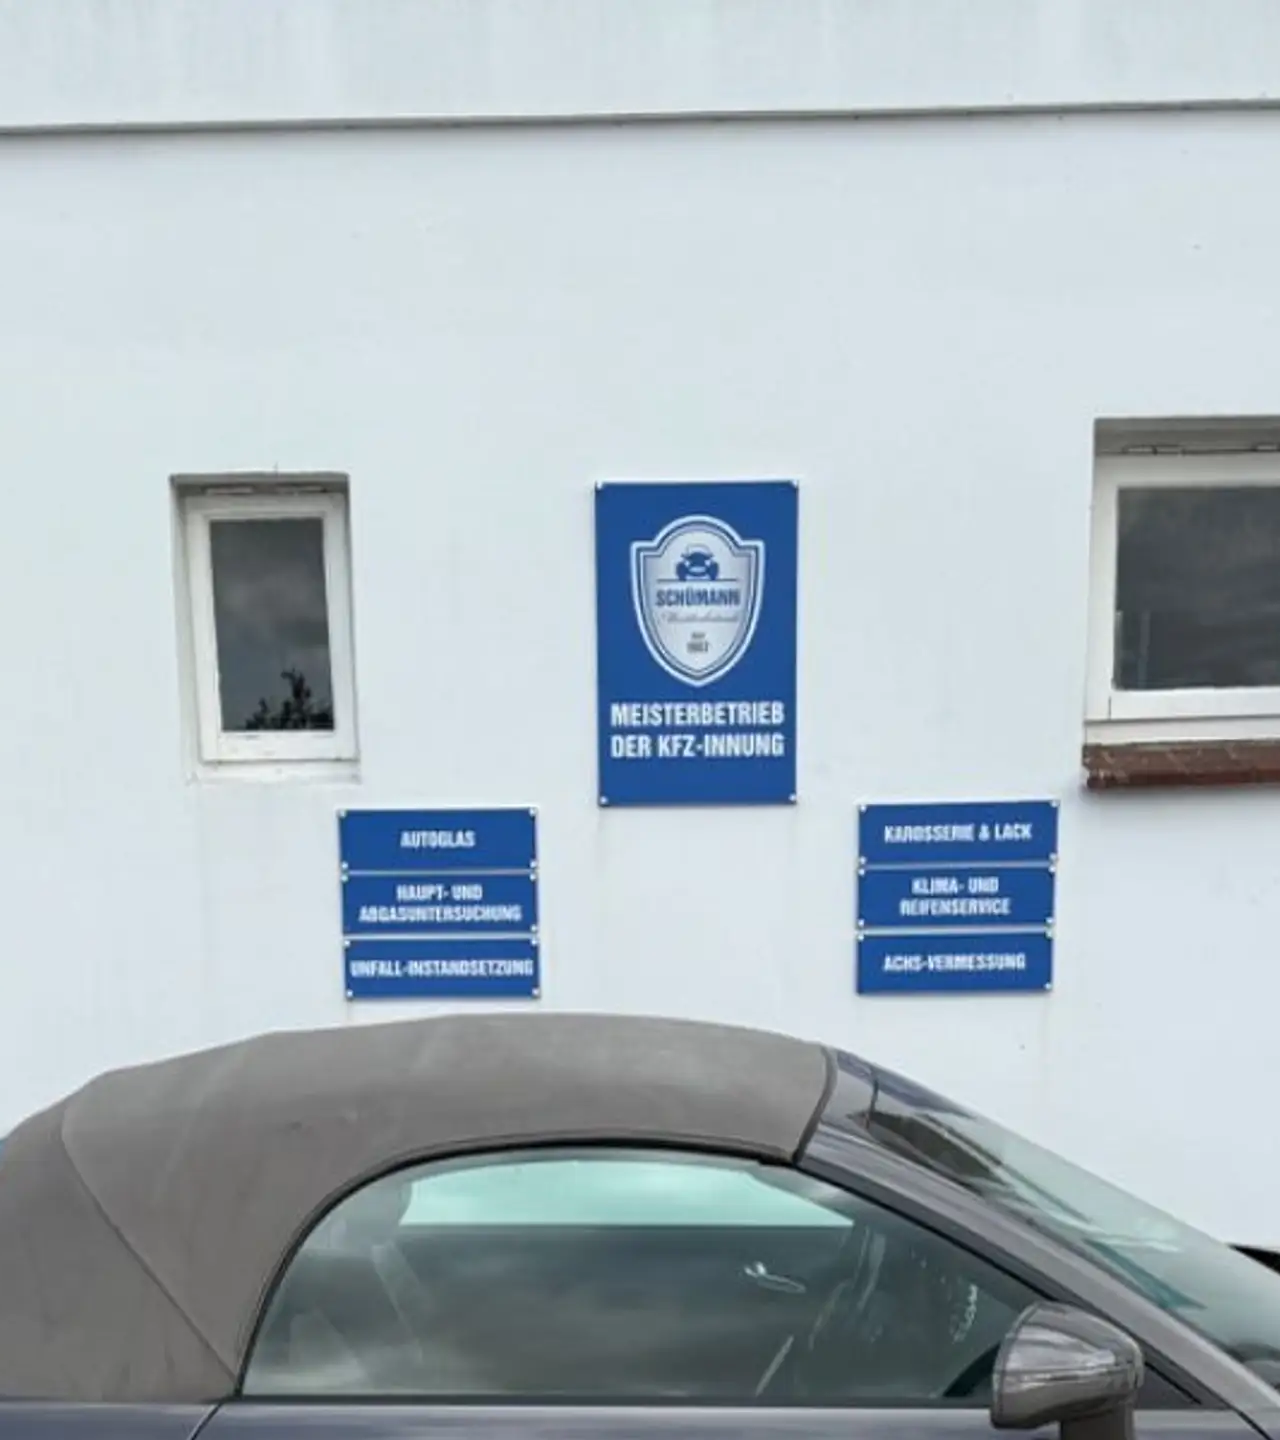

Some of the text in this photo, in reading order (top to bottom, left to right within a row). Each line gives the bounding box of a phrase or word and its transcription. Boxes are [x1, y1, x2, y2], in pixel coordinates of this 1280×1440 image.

[655, 586, 740, 607] SCHÜMANN
[611, 701, 784, 727] MEISTERBETRIEB
[611, 733, 784, 758] DER KFZ-INNUNG
[400, 830, 476, 848] AUTOGLAS
[884, 823, 1032, 843] KAROSSERIE & LACK
[397, 884, 482, 901] HAUPT- UND
[912, 877, 999, 895] KLIMA- UND
[358, 905, 522, 922] ABGASUNTERSUCHUNG
[899, 898, 1011, 916] REIFENSERVICE
[350, 959, 534, 978] UNFALL-INSTANDSETZUNG
[884, 954, 1026, 972] ACHS-VERMESSUNG
